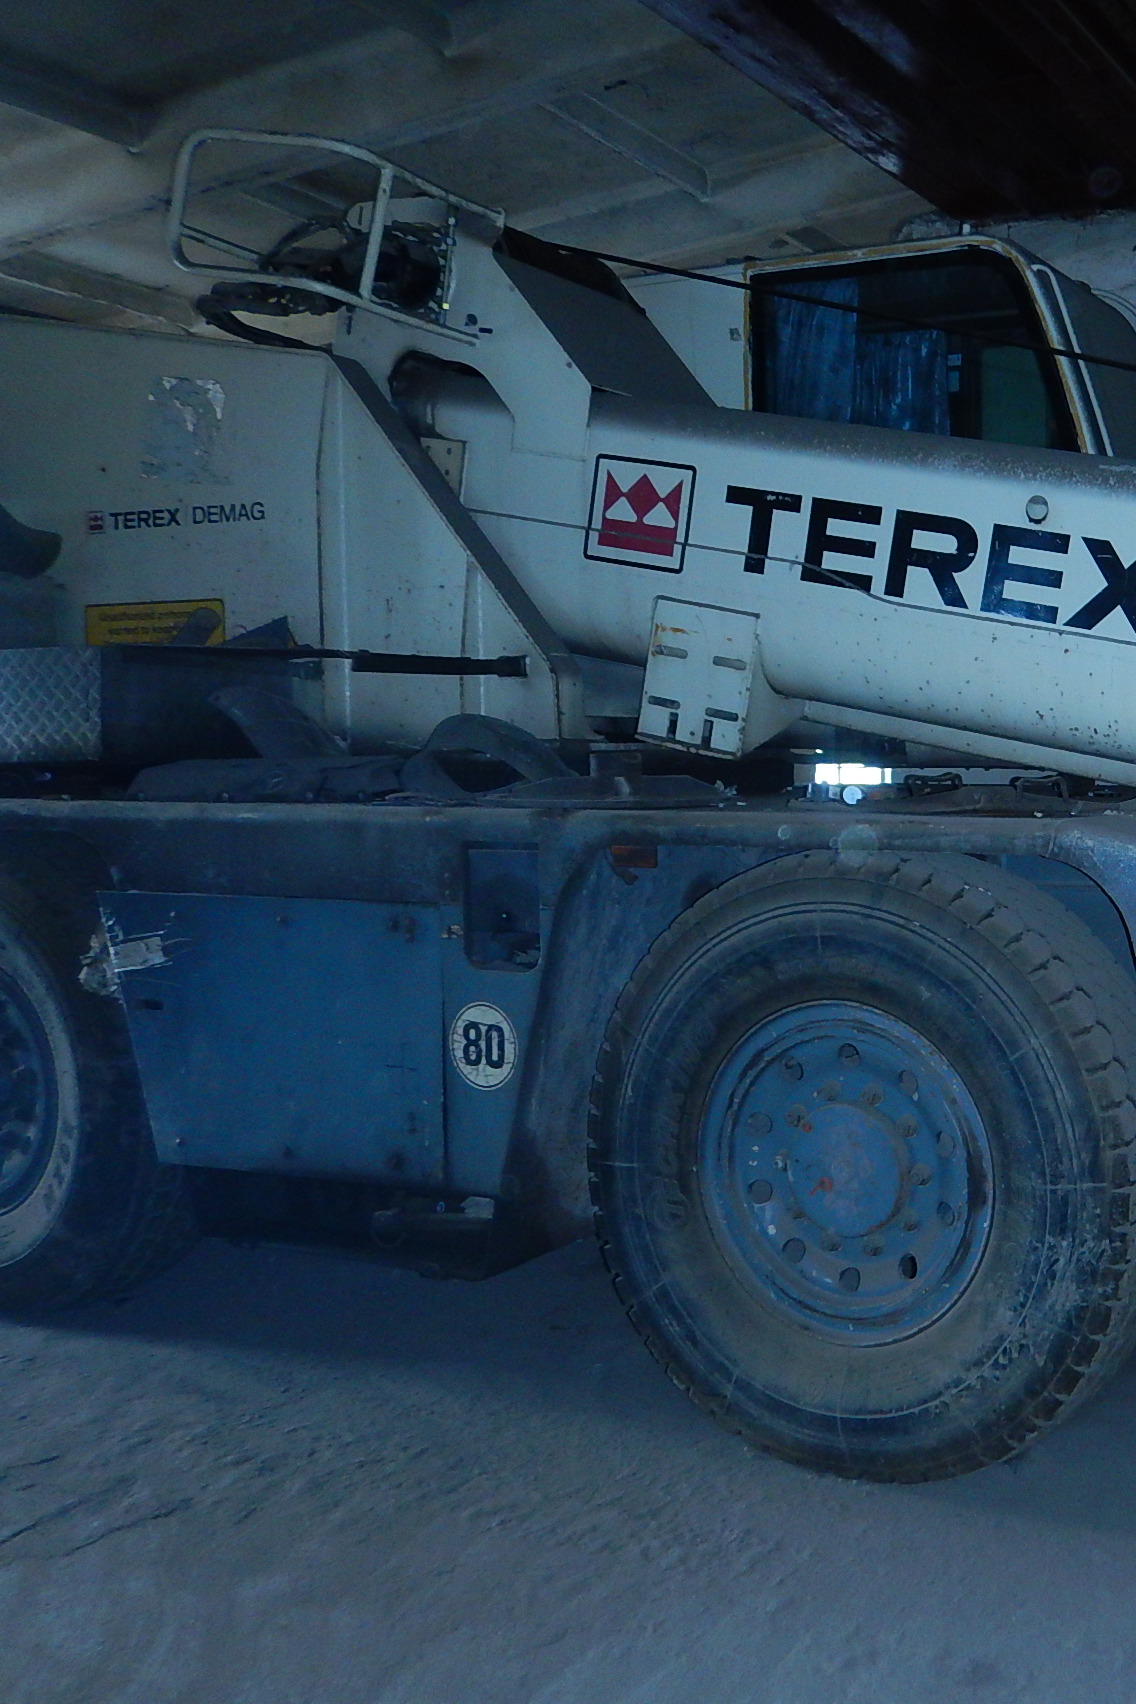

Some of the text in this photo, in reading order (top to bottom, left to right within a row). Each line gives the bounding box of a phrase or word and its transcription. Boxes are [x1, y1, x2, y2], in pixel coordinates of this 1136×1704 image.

[109, 501, 266, 531] TEREX DEMAG
[462, 1021, 506, 1070] 80
